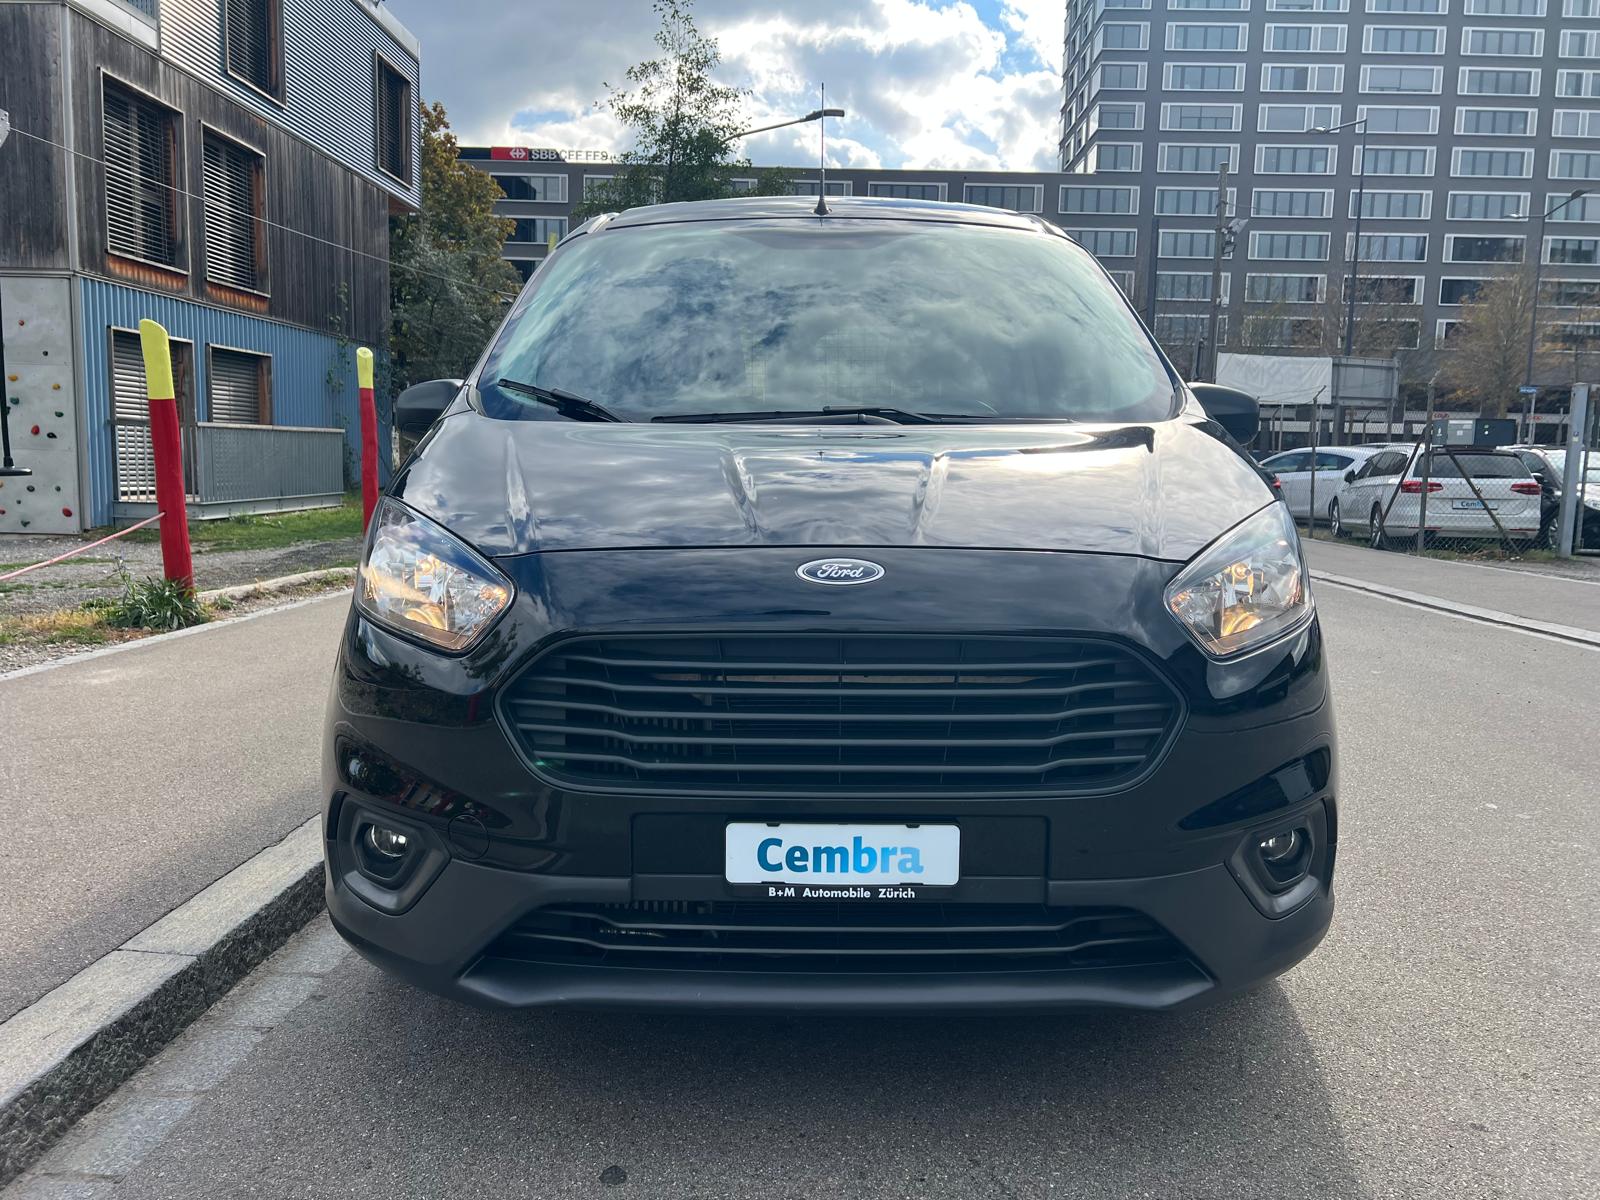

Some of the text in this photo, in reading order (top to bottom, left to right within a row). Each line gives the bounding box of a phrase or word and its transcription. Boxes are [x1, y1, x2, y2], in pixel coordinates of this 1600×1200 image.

[531, 149, 557, 160] SBB
[560, 150, 582, 160] CFF
[817, 563, 864, 578] Ford
[757, 836, 924, 874] Cembra
[768, 887, 916, 899] B+M Automobile Zürich
